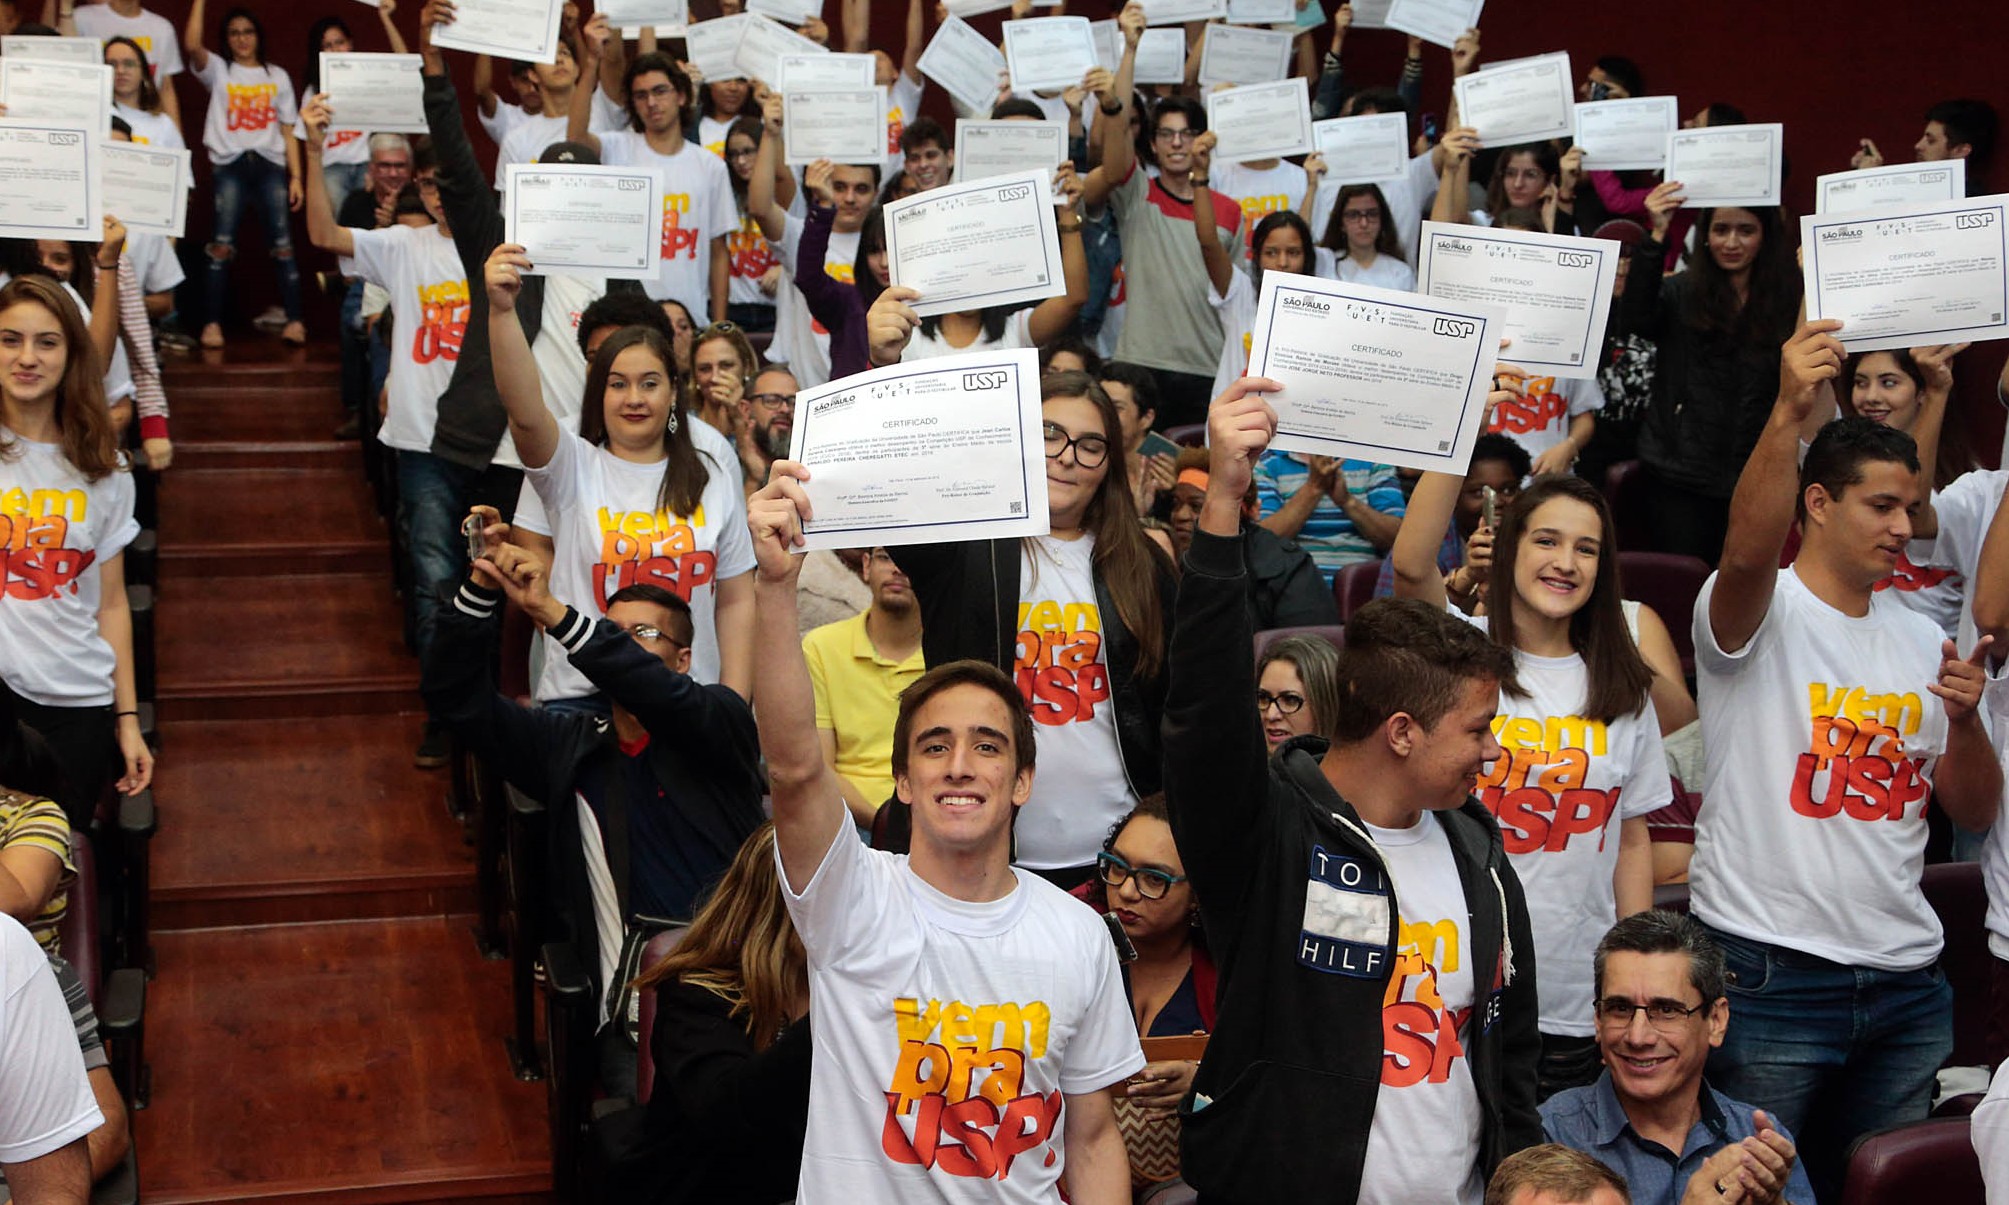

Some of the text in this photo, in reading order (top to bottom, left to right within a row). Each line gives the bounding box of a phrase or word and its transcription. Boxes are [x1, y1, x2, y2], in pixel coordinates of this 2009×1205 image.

[998, 186, 1029, 202] USP
[1236, 193, 1289, 217] em
[1956, 212, 1994, 230] USP
[1557, 252, 1593, 268] USP
[1888, 250, 1936, 262] CERTIFICADO
[1283, 296, 1301, 307] SÃO
[1302, 301, 1331, 311] PAULO
[1433, 317, 1475, 339] USP
[413, 322, 467, 365] US
[1351, 344, 1403, 358] CERTIFICADO
[963, 371, 1008, 391] USP
[1334, 371, 1362, 380] PROFESSOR
[814, 402, 829, 413] SÃO
[831, 394, 856, 407] PAULO
[882, 417, 938, 429] CERTIFICADO
[0, 486, 88, 522] em
[0, 547, 97, 601] SP!
[889, 1039, 1026, 1116] pra
[882, 1088, 1063, 1182] USP!
